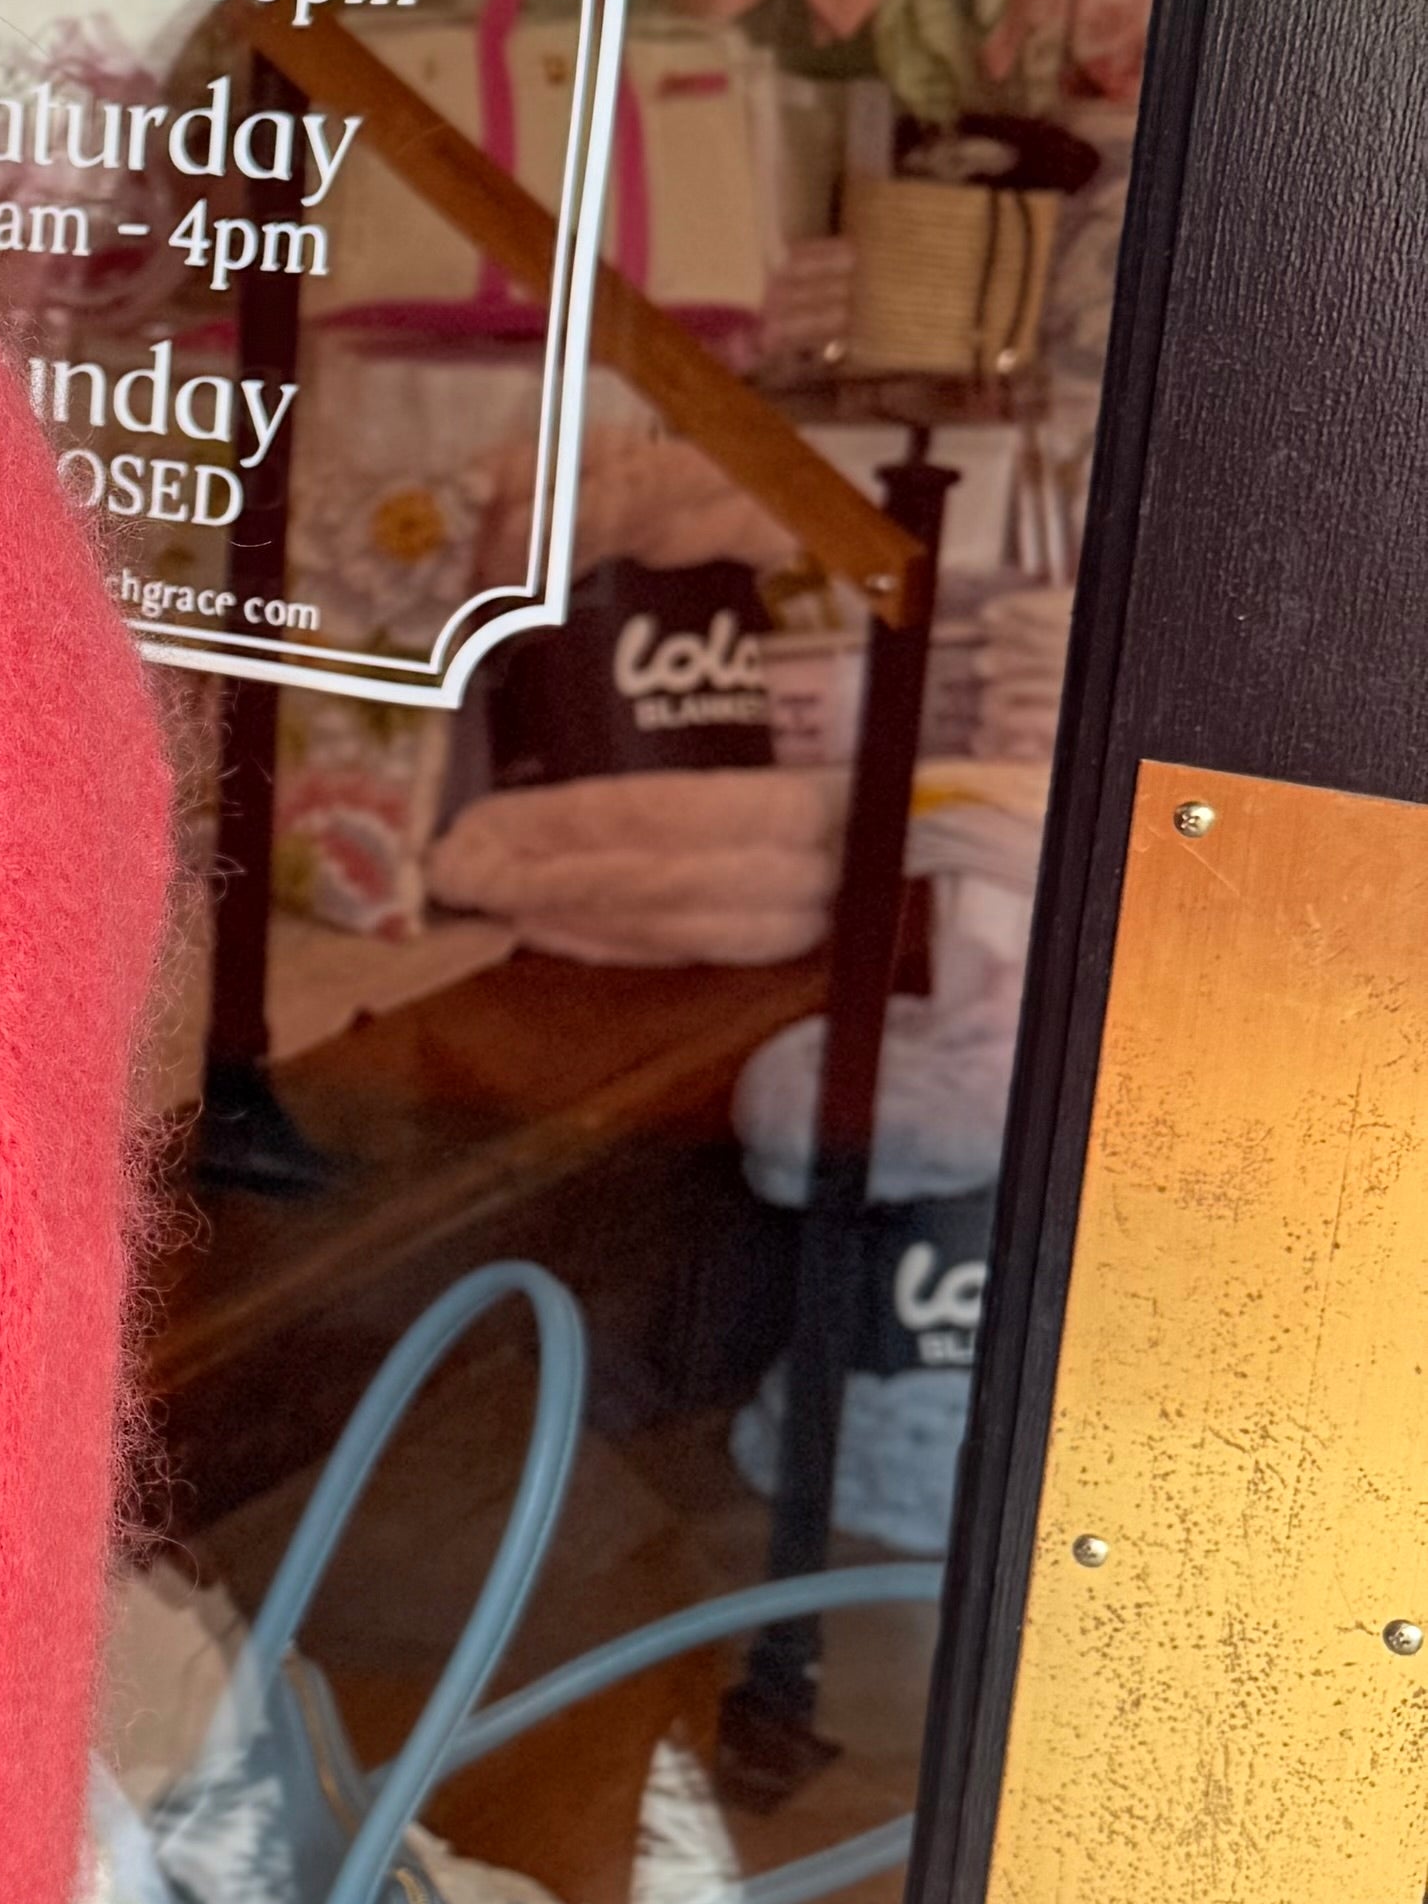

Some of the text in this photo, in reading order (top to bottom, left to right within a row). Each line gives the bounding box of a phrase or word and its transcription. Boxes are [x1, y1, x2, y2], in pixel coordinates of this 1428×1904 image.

[166, 197, 331, 291] 4pm
[28, 338, 301, 469] nday
[56, 448, 245, 527] OSED
